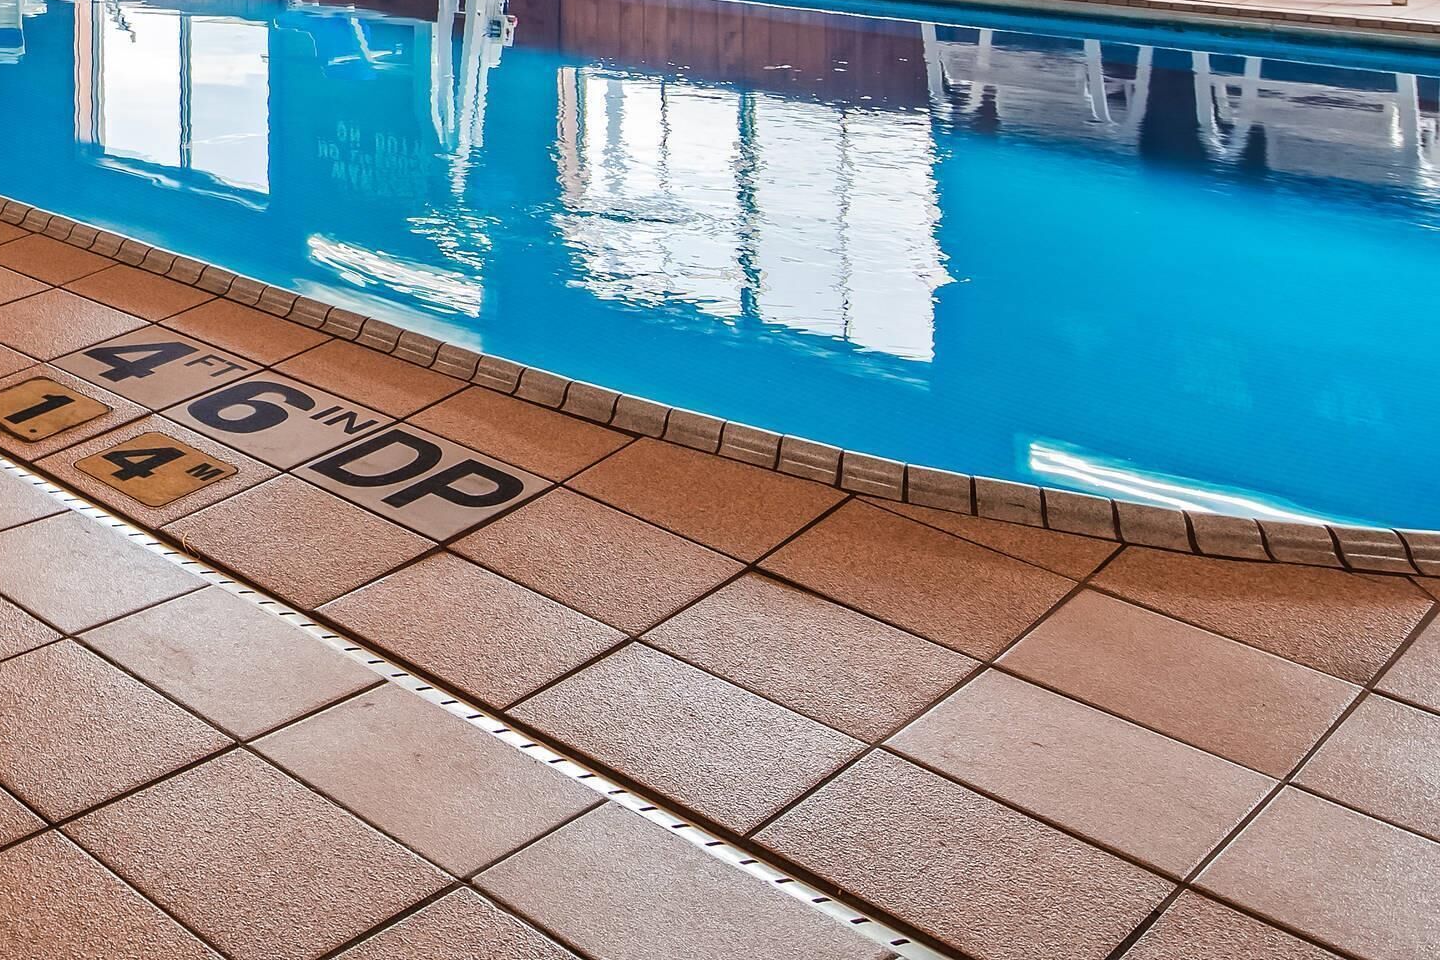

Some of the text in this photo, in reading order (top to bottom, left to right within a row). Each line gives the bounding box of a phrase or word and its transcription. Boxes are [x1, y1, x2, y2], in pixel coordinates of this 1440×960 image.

[82, 340, 524, 510] 4 FT 6 IN DP
[100, 446, 184, 482] 4
[184, 462, 220, 482] M
